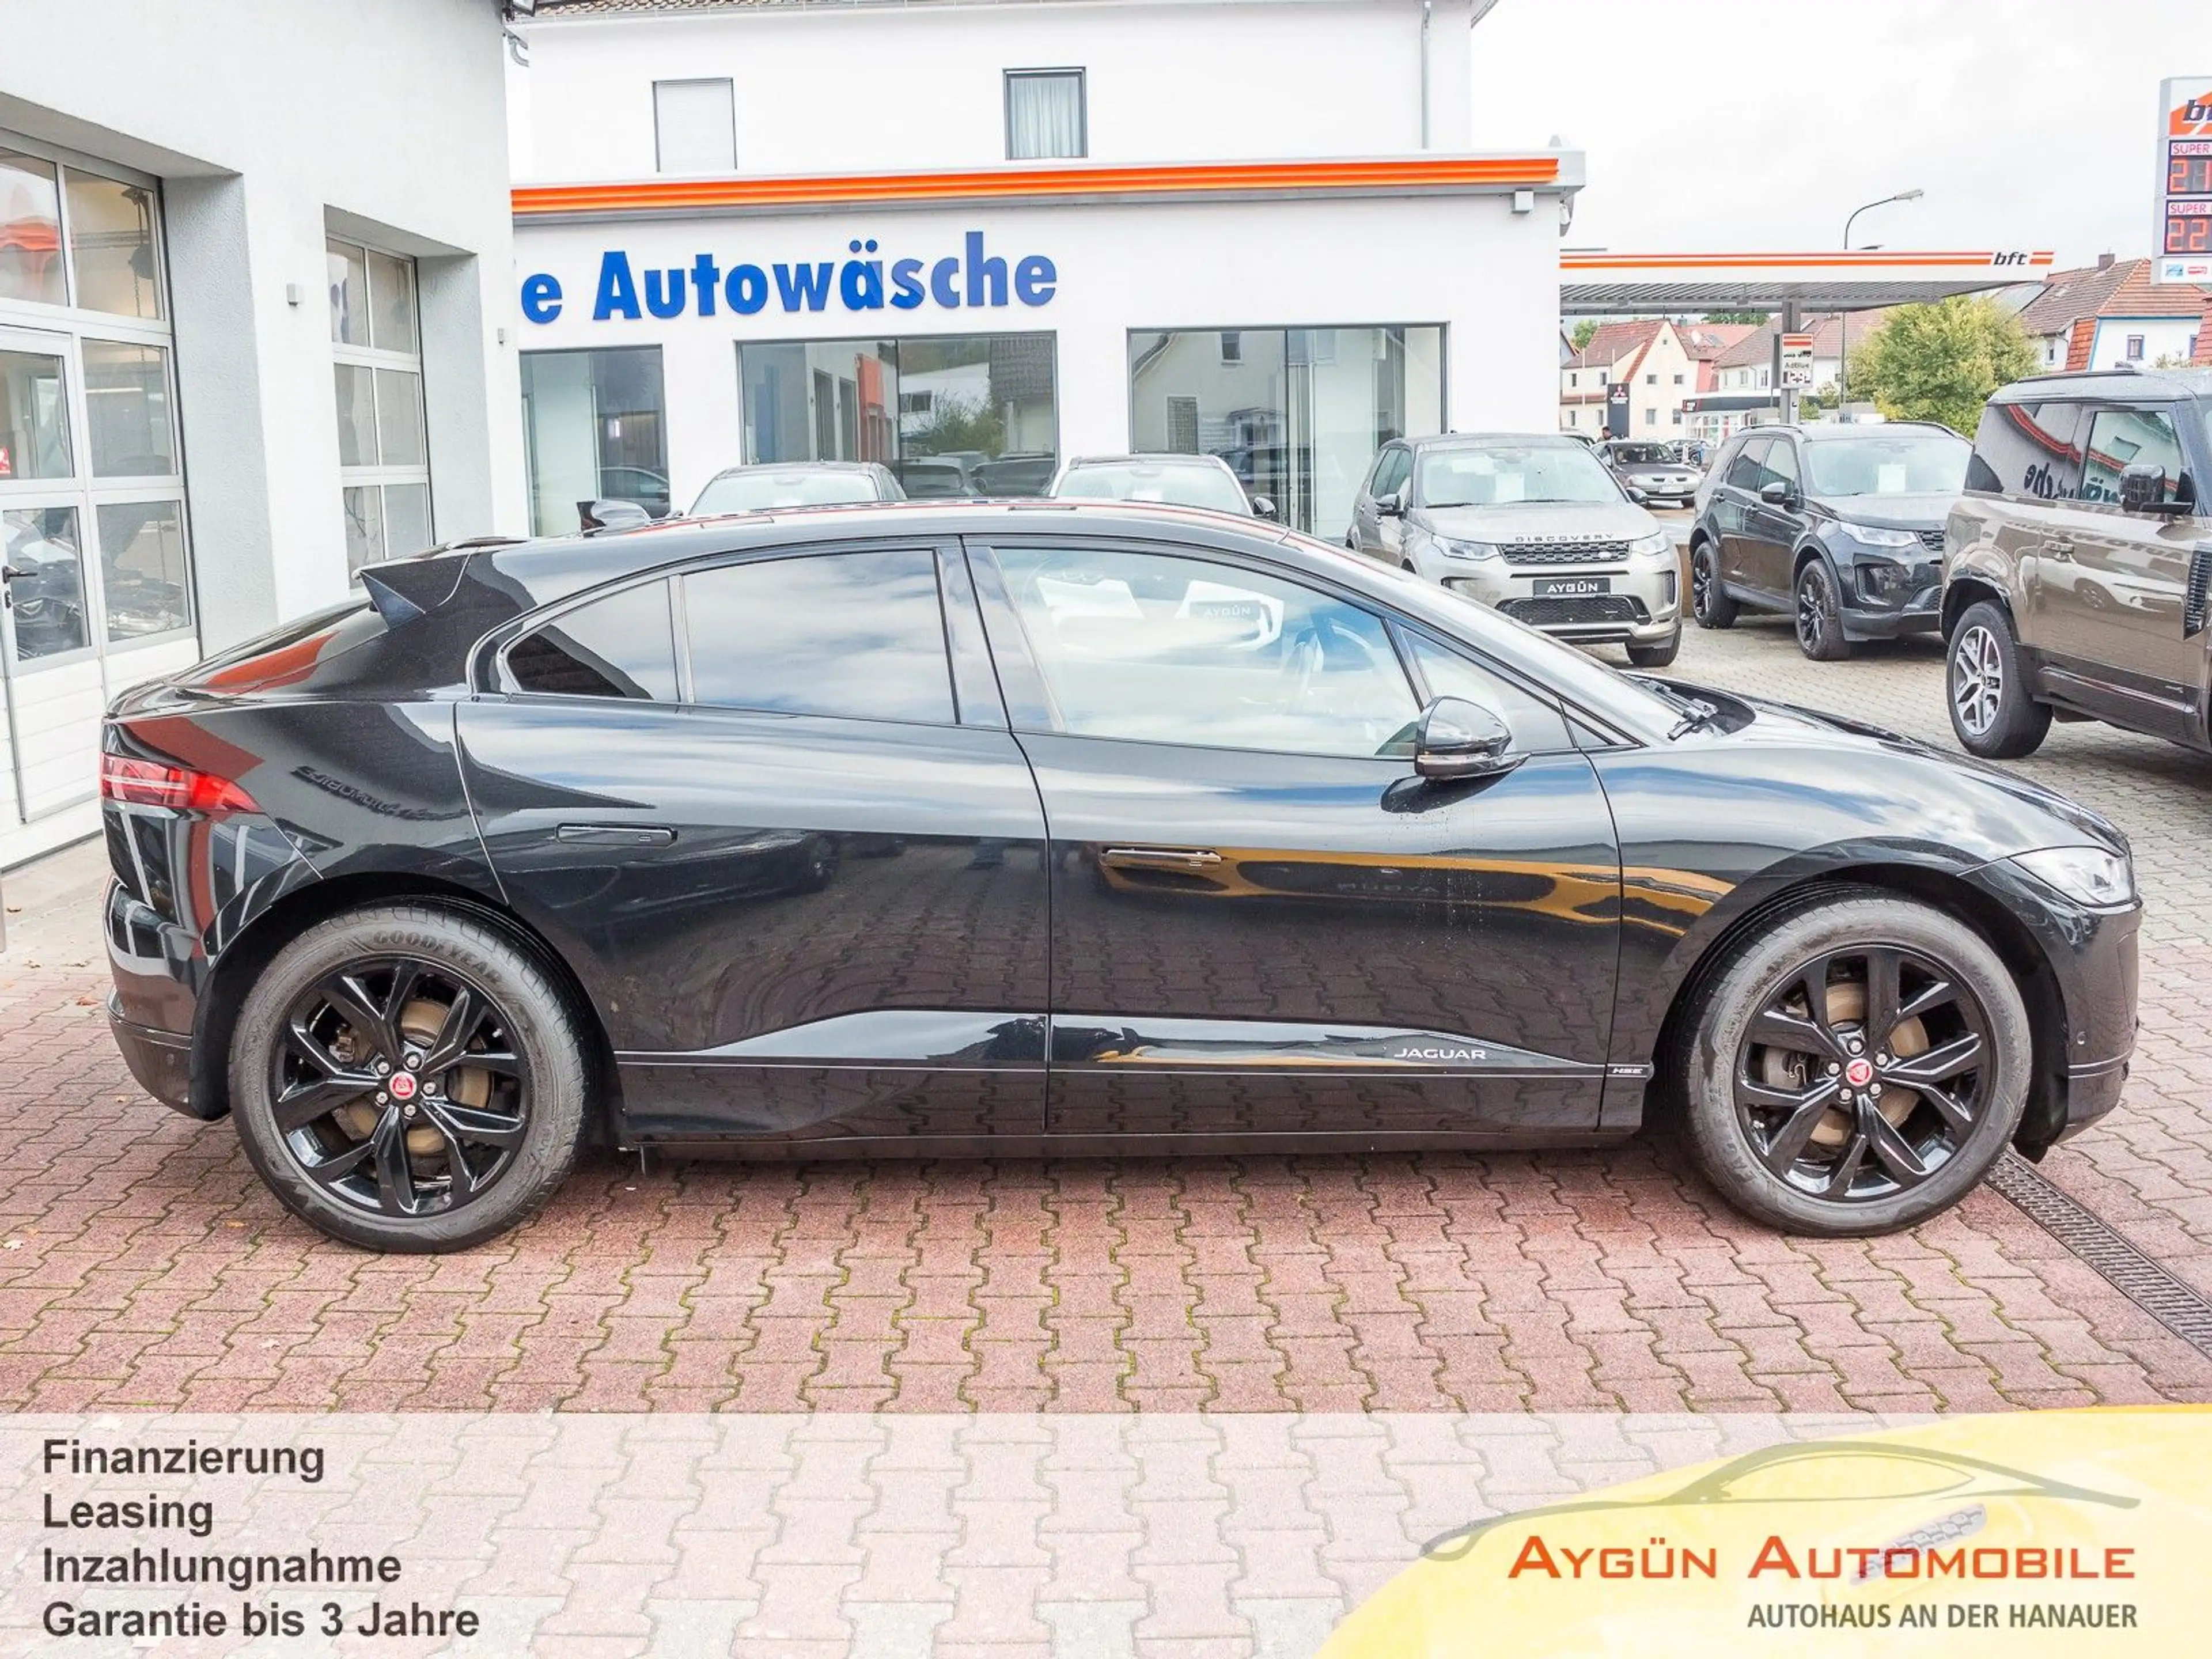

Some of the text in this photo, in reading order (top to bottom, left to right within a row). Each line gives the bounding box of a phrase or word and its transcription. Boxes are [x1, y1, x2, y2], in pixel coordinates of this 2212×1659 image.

[2183, 99, 2212, 121] b
[2173, 143, 2210, 154] SUPER
[2170, 203, 2207, 214] SUPER
[1994, 252, 2028, 265] bft
[593, 231, 1056, 320] Autowäsche
[1515, 533, 1614, 542] DISCOVERY
[1547, 581, 1598, 594] AYGÜN
[374, 930, 502, 983] GOODYEAR
[1394, 1048, 1487, 1060] JAGUAR
